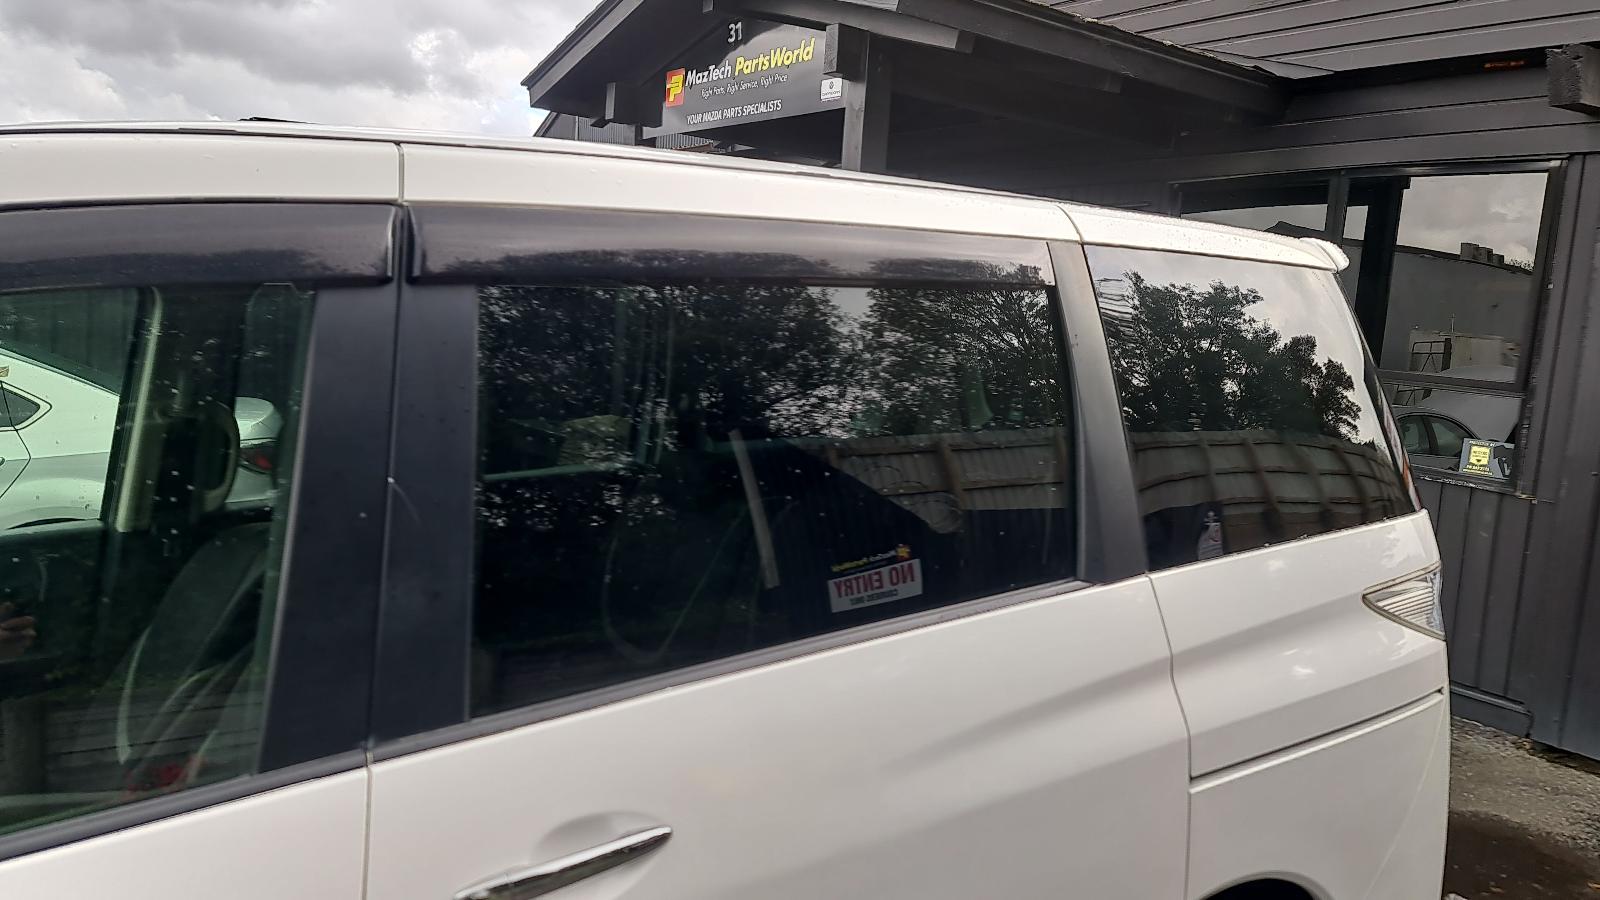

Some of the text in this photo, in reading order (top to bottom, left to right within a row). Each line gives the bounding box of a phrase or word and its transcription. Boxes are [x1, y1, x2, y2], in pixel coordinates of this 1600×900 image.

[727, 21, 742, 43] 31
[685, 37, 815, 86] MazTech PartsWorld
[686, 99, 782, 125] YOUR MAZDA PARTS SPECIALISTS
